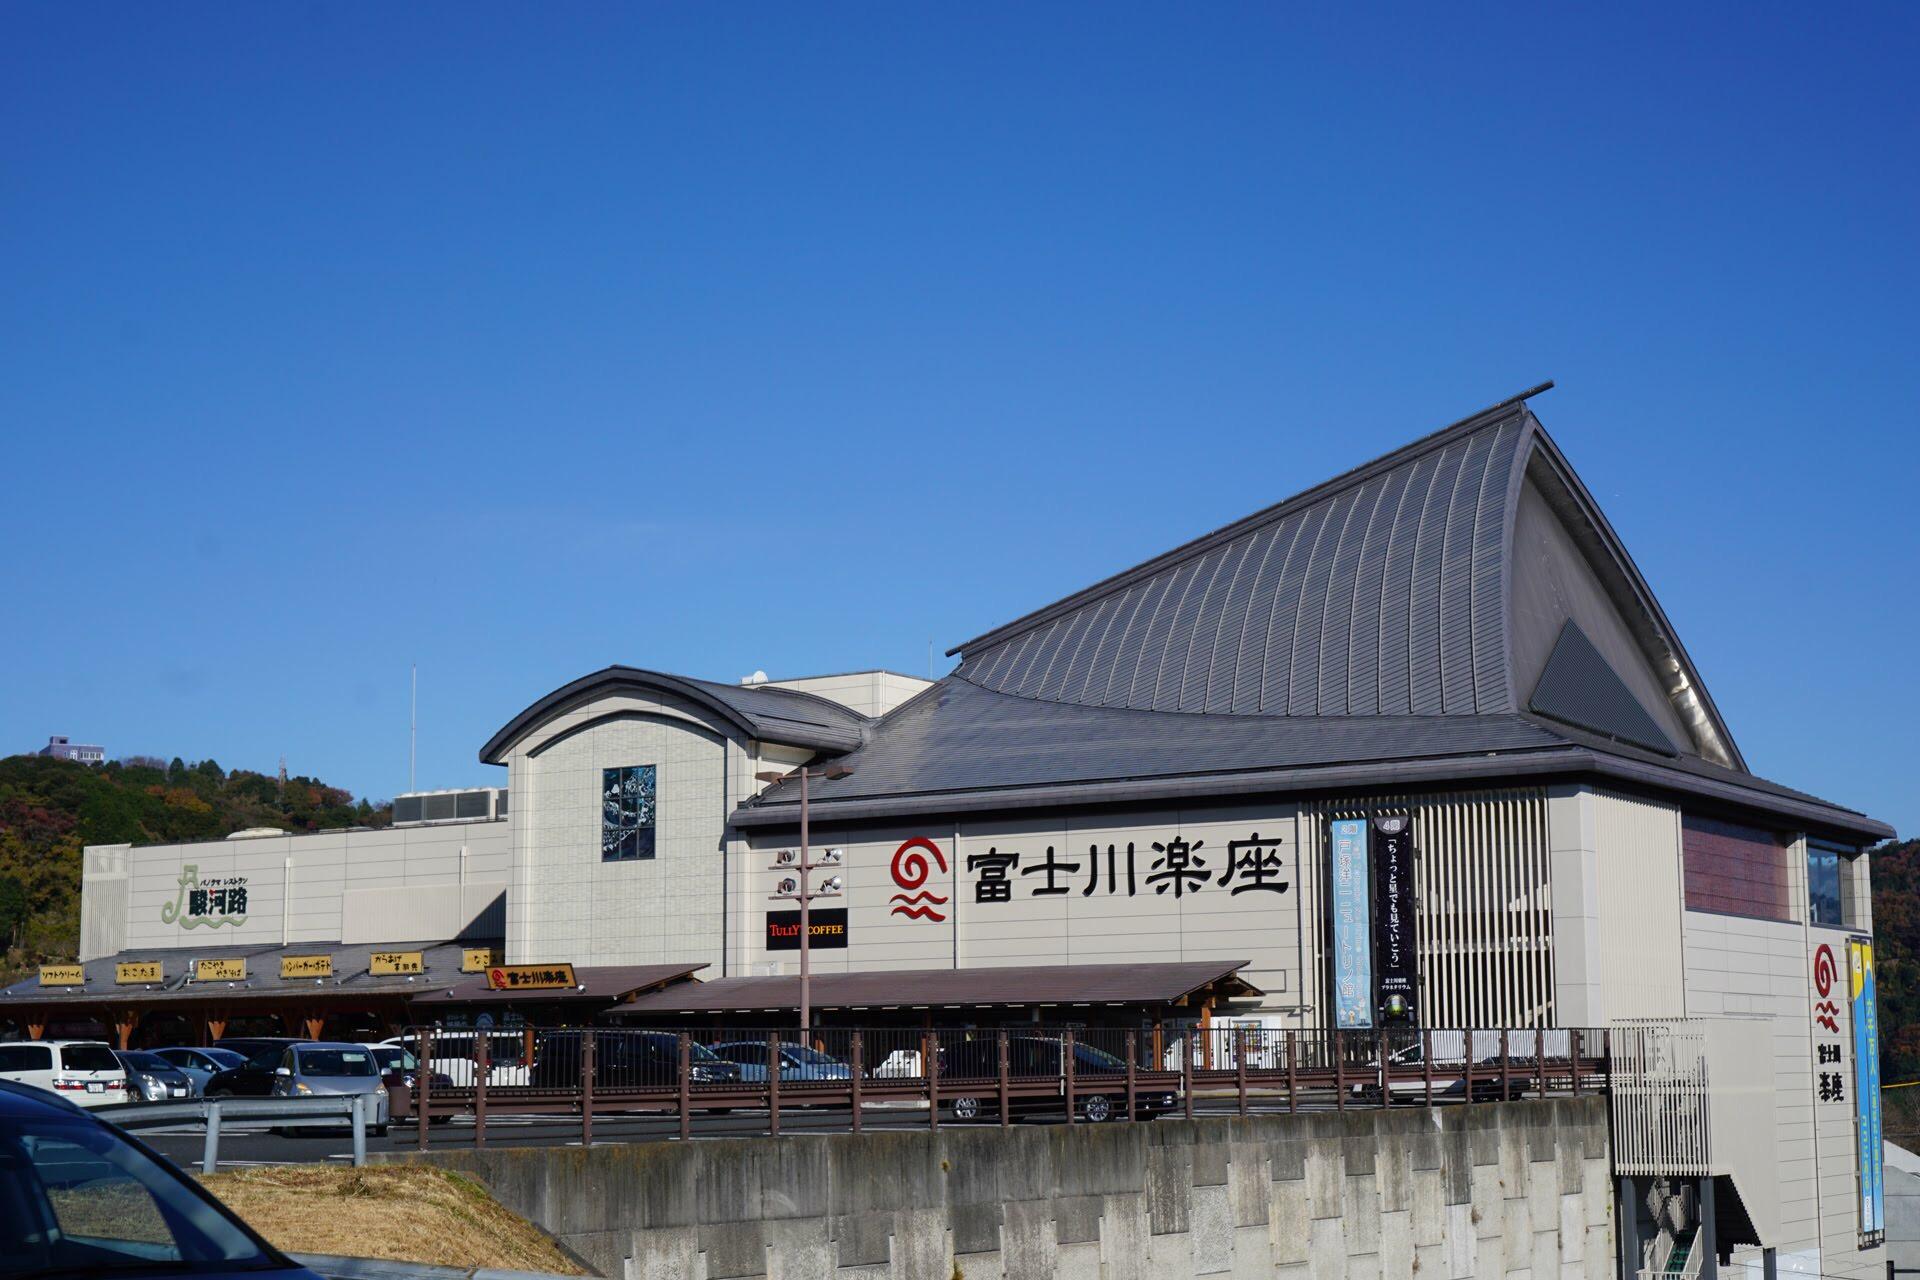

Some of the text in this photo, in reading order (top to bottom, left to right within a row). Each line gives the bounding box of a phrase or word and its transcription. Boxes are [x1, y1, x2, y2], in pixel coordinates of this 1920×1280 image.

[1383, 819, 1401, 831] 4階
[967, 832, 1289, 904] 富士川楽座
[769, 924, 843, 936] TULLY COFFEE
